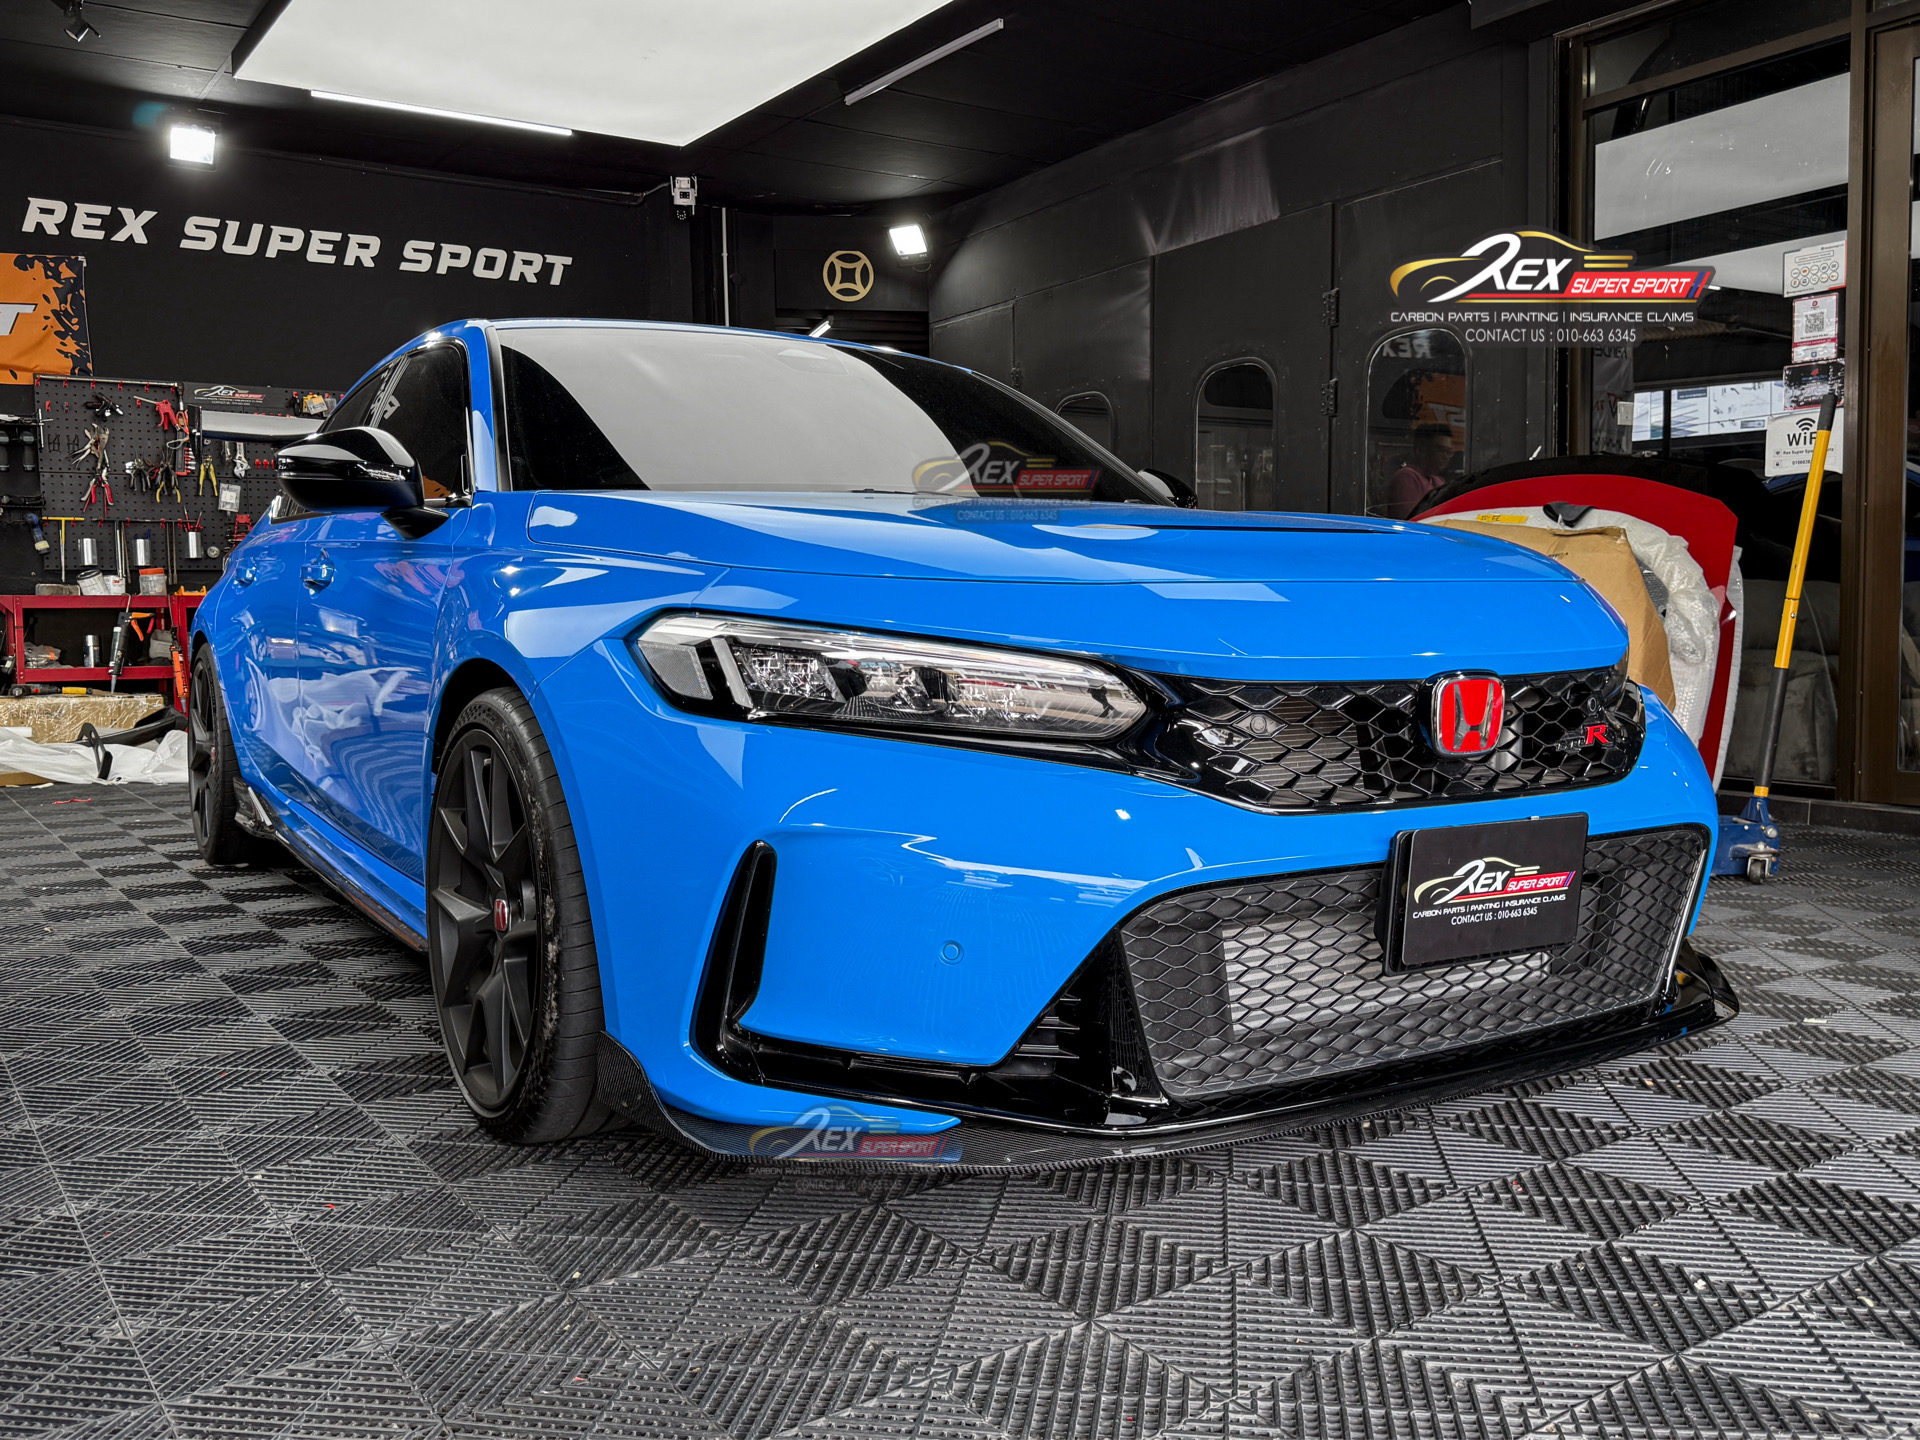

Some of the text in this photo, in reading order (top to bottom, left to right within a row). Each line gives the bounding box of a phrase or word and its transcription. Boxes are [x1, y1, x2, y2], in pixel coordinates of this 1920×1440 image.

[21, 197, 573, 286] REX SUPER SPORT
[1787, 431, 1817, 446] WiF
[1585, 724, 1610, 745] R
[1433, 859, 1510, 905] REX
[1507, 875, 1567, 891] SUPER SPORT
[1412, 908, 1442, 919] CARBON
[1443, 905, 1466, 915] PARTS
[1470, 901, 1500, 912] PAINTING
[1505, 896, 1541, 907] INSURANCE
[1542, 893, 1566, 903] CLAIMS
[1451, 913, 1483, 926] CONTACT
[1484, 911, 1493, 921] US
[1497, 908, 1522, 920] 010-663
[1522, 906, 1538, 917] 6345
